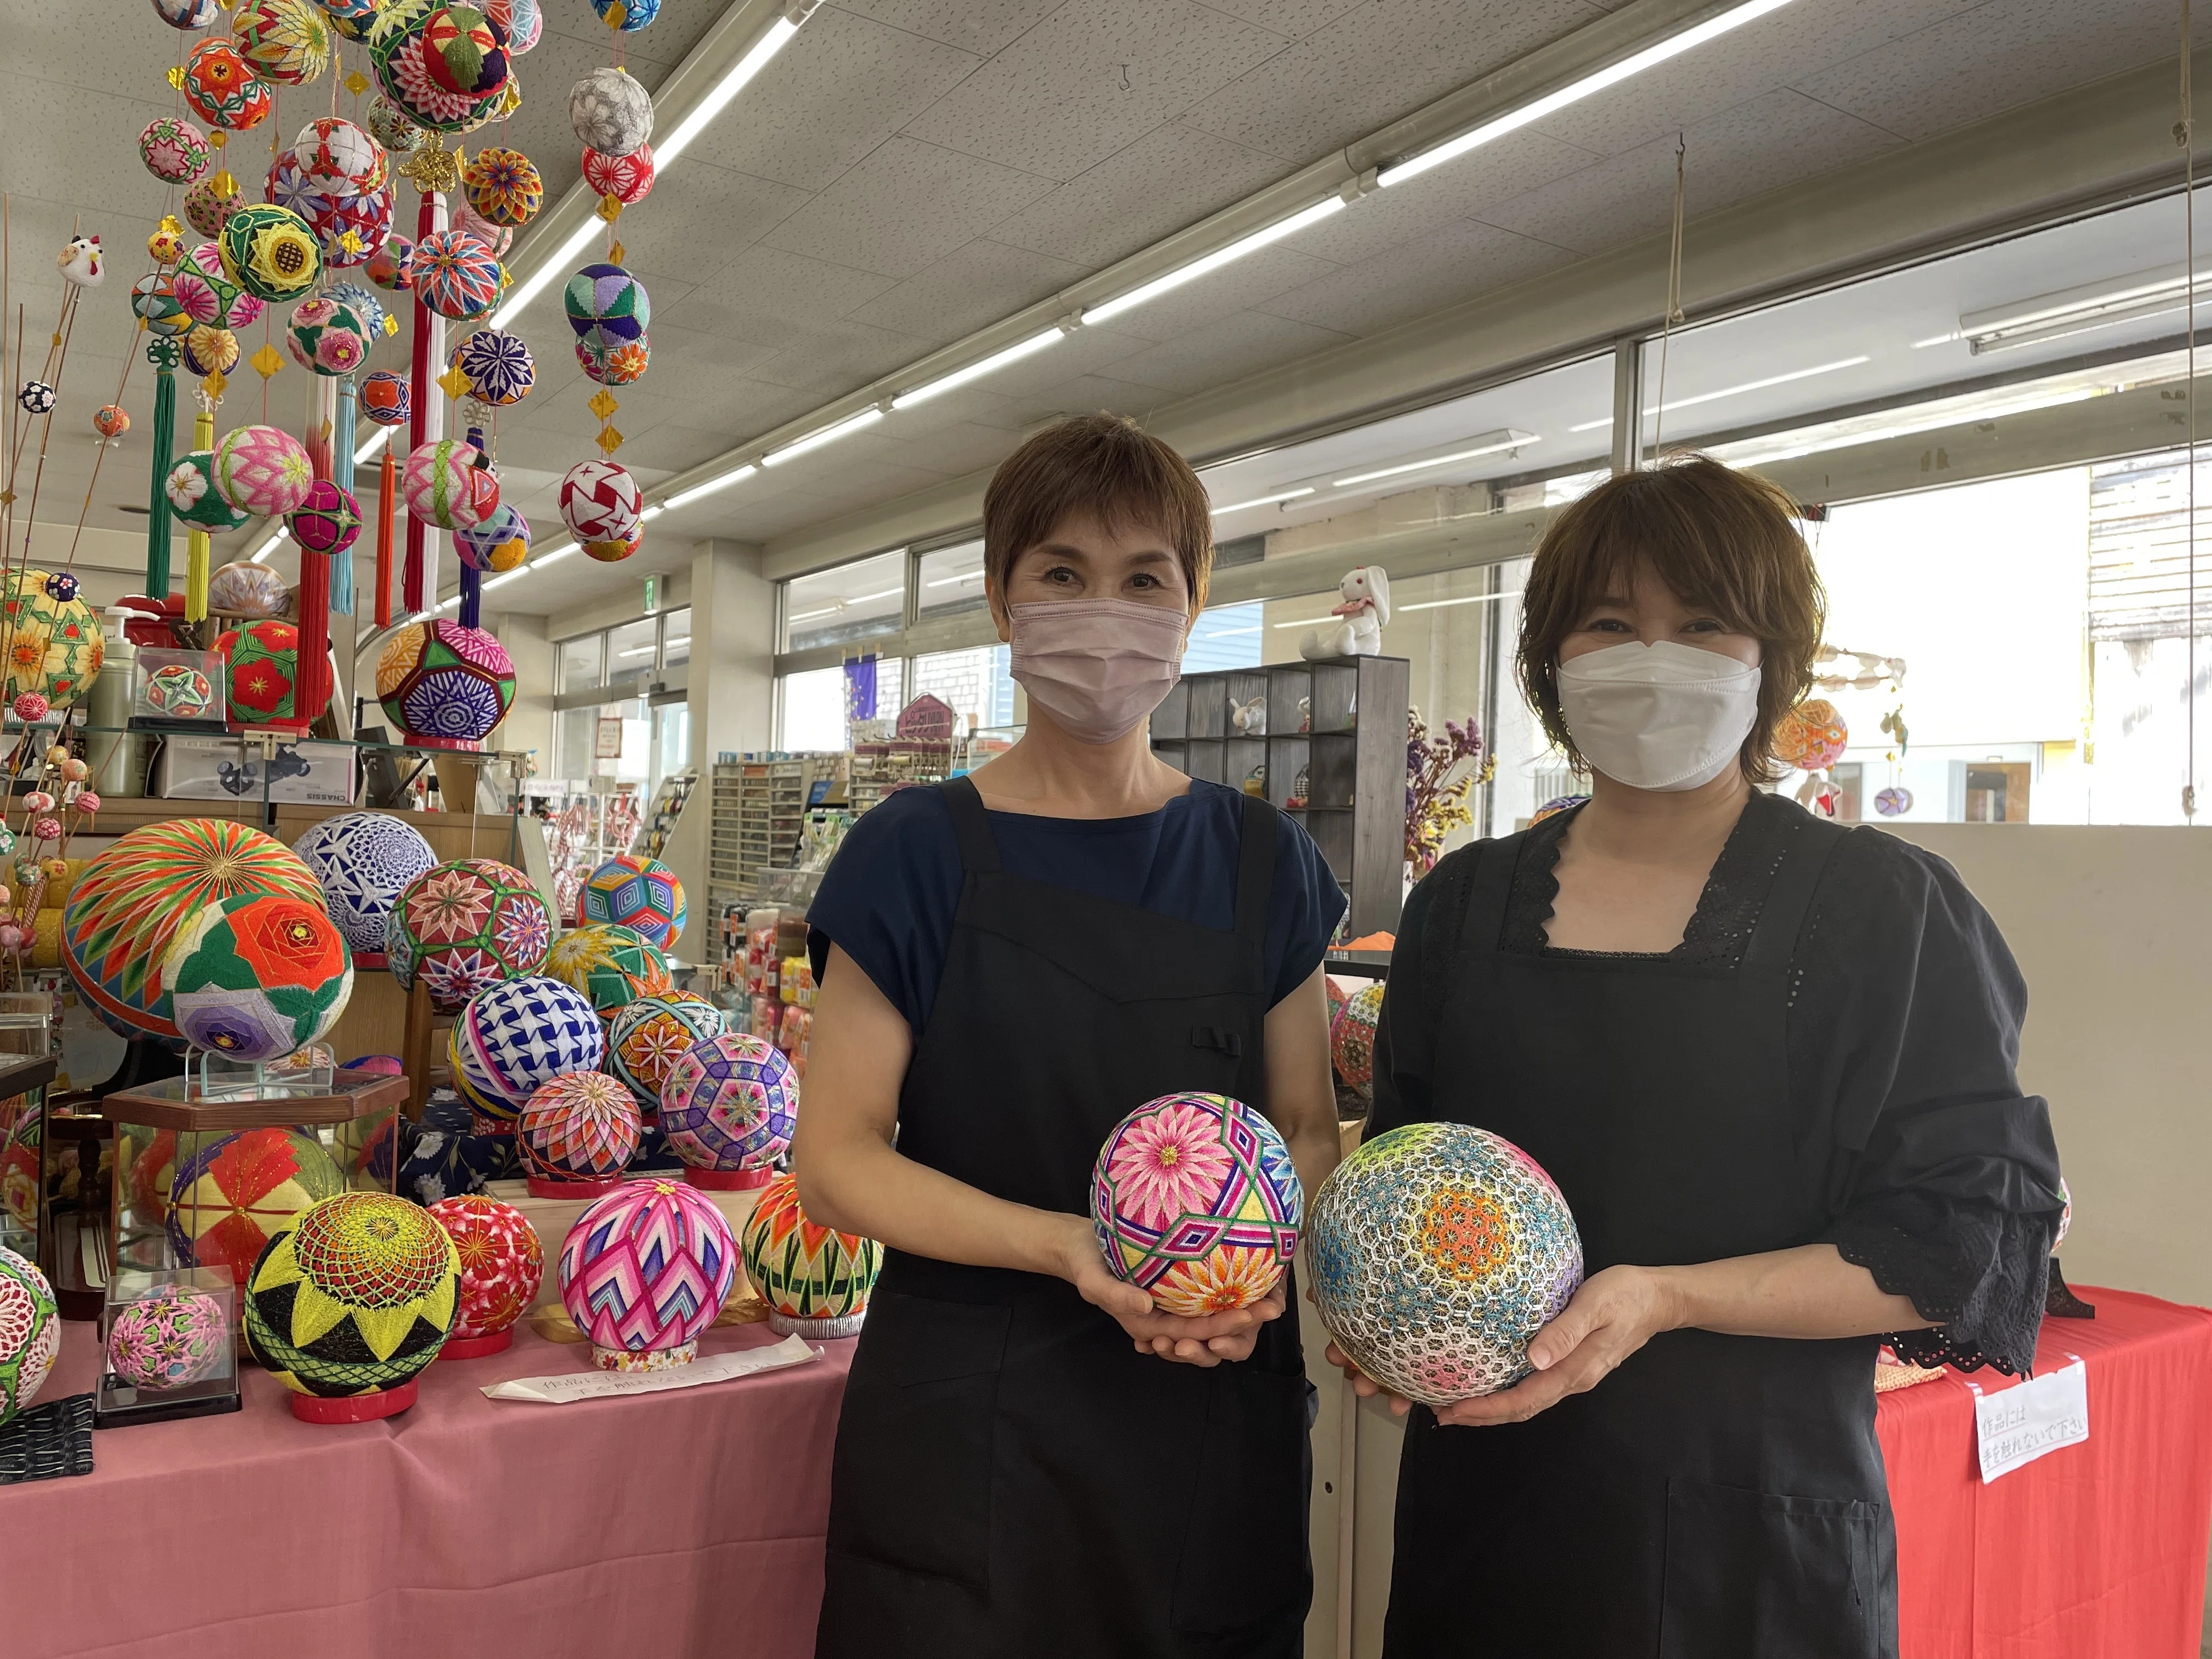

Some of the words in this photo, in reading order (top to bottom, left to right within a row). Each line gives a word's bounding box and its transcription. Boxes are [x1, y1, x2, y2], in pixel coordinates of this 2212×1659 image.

[307, 793, 346, 802] CHASSIS
[1982, 1404, 2025, 1438] 作品には
[1983, 1417, 2086, 1468] 手を触れないで下さい
